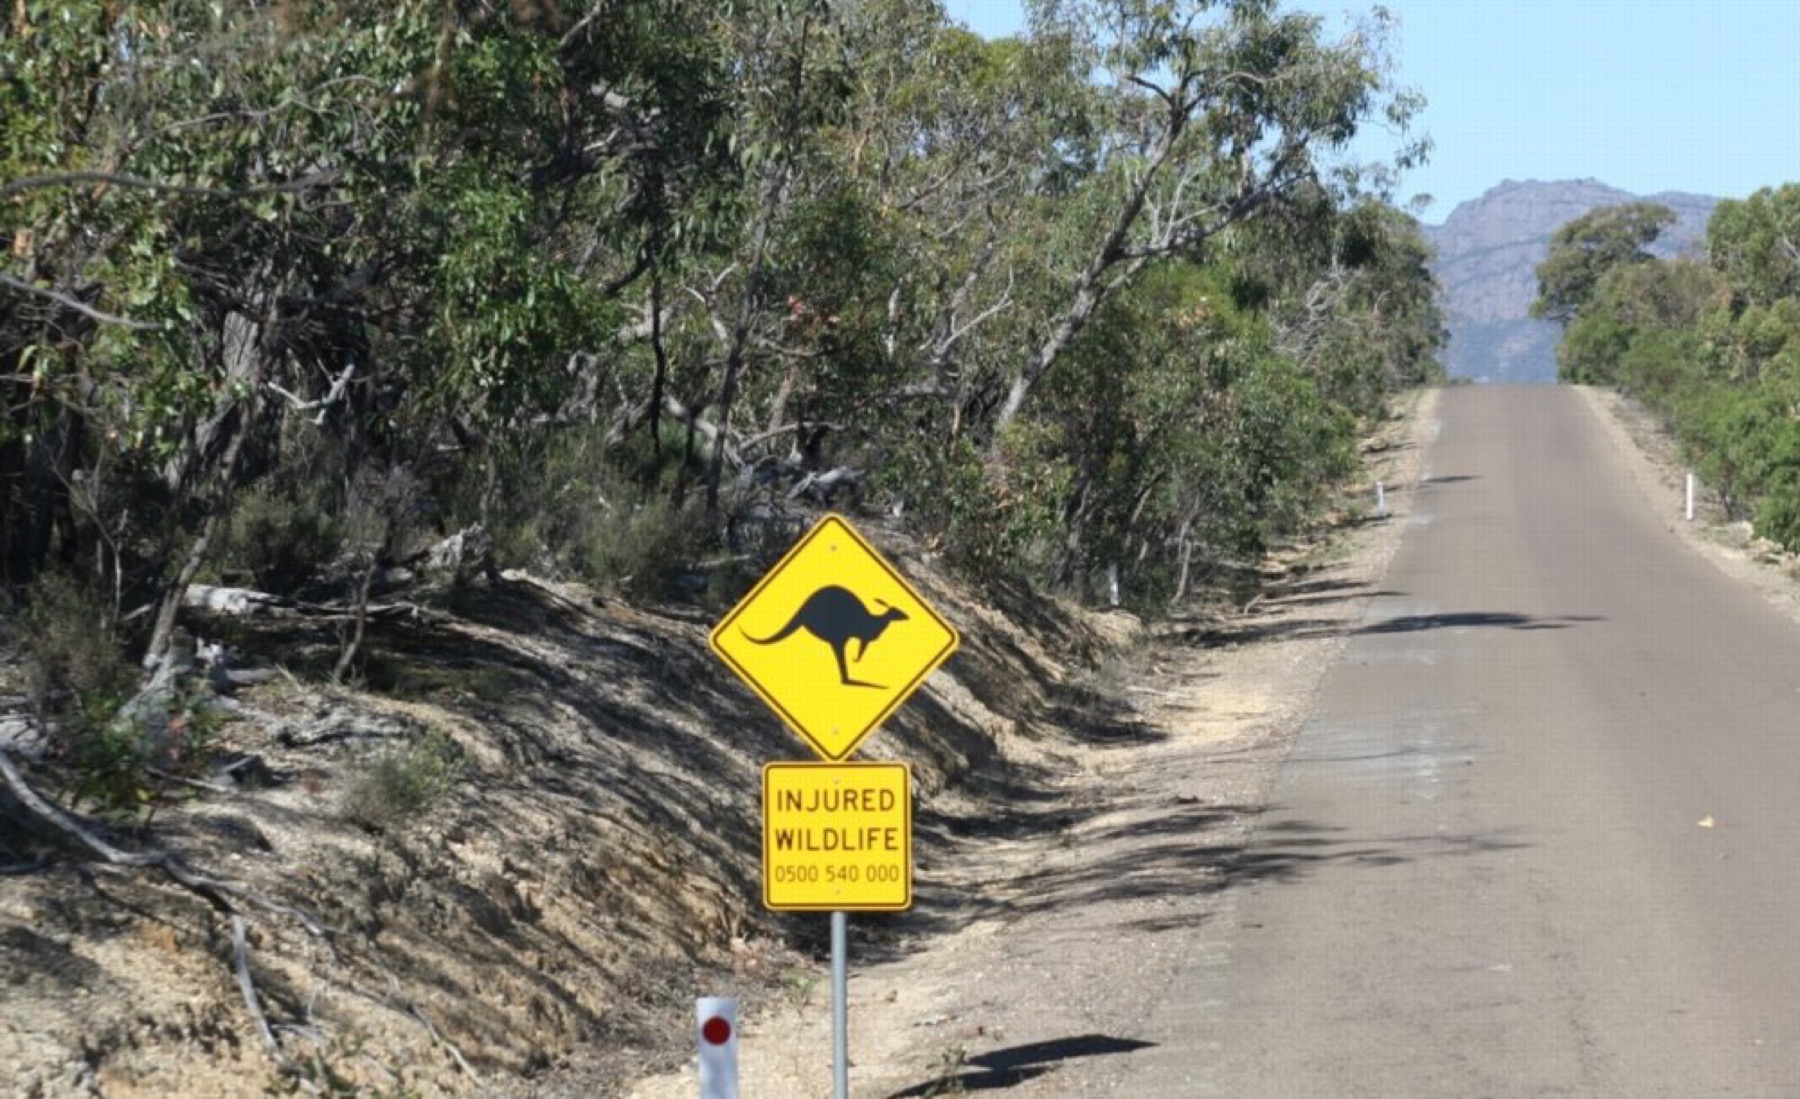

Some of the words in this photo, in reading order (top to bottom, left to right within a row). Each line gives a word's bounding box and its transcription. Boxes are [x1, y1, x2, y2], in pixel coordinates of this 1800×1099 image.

[777, 789, 895, 812] INJURED
[775, 828, 899, 850] WILDLIFE
[775, 865, 818, 882] 0500
[826, 865, 859, 882] 540
[866, 865, 899, 882] 000
